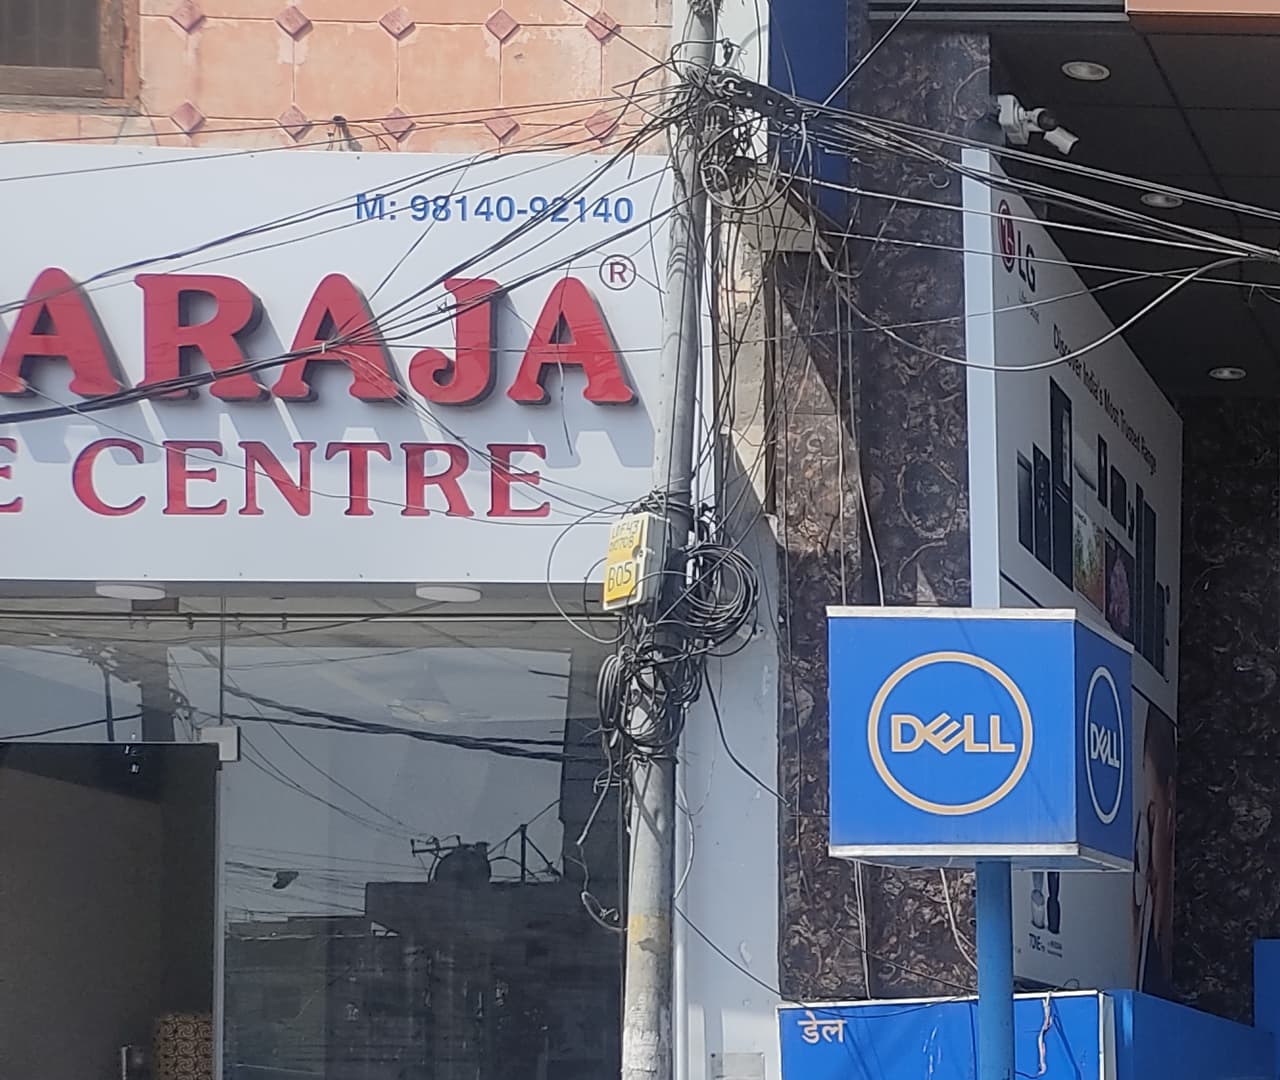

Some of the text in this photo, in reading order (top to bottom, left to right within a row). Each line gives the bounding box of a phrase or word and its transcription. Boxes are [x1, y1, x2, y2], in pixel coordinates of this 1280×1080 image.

[354, 193, 635, 225] M: 98140-92140
[0, 267, 638, 407] ARAJA
[71, 438, 552, 518] CENTRE
[889, 711, 1017, 755] DELL
[1089, 721, 1121, 771] DELL
[797, 1010, 848, 1045] डेल
